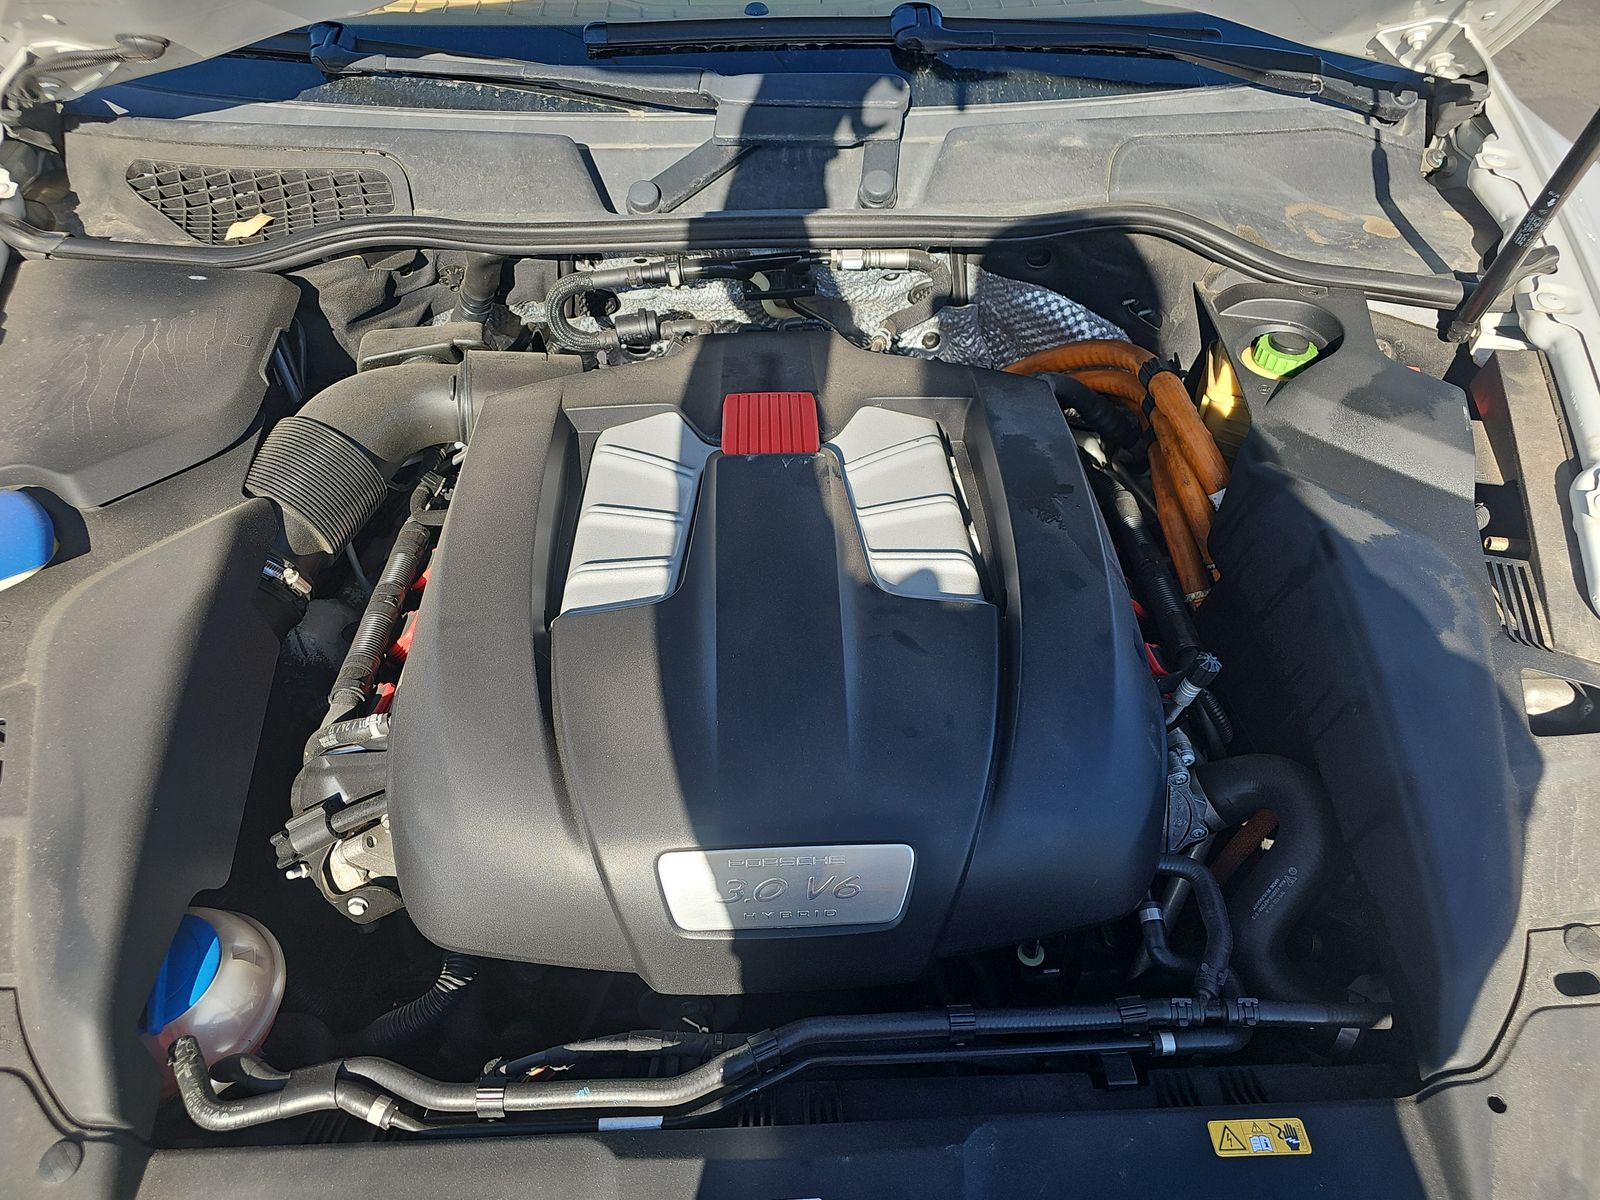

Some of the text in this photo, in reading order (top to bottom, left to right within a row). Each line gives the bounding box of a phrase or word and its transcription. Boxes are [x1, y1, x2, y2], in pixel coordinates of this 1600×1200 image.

[728, 854, 846, 868] PORSCHE
[716, 874, 862, 904] 3.0 V6
[743, 909, 837, 920] HYBRID
